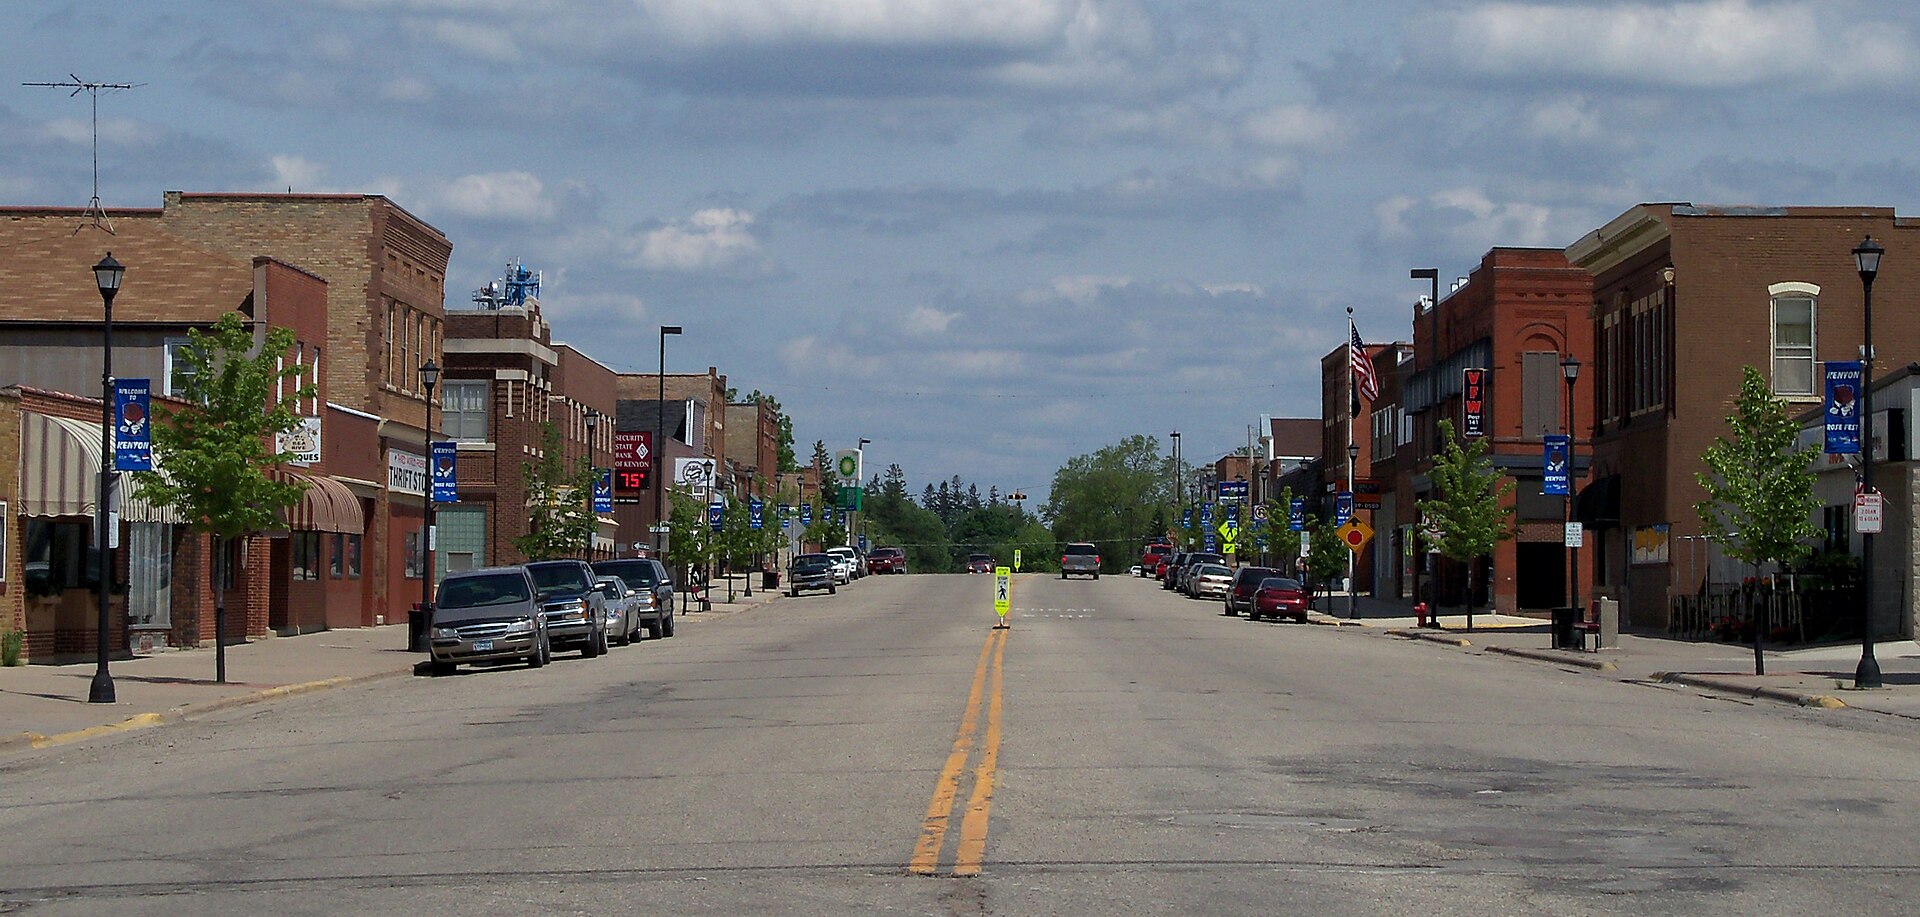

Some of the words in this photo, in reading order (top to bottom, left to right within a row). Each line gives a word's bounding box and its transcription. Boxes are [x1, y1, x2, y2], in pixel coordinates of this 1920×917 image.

[1826, 371, 1860, 380] KENYON
[1466, 371, 1482, 413] VFW
[116, 441, 150, 450] KENYON
[390, 466, 413, 490] THRIFT
